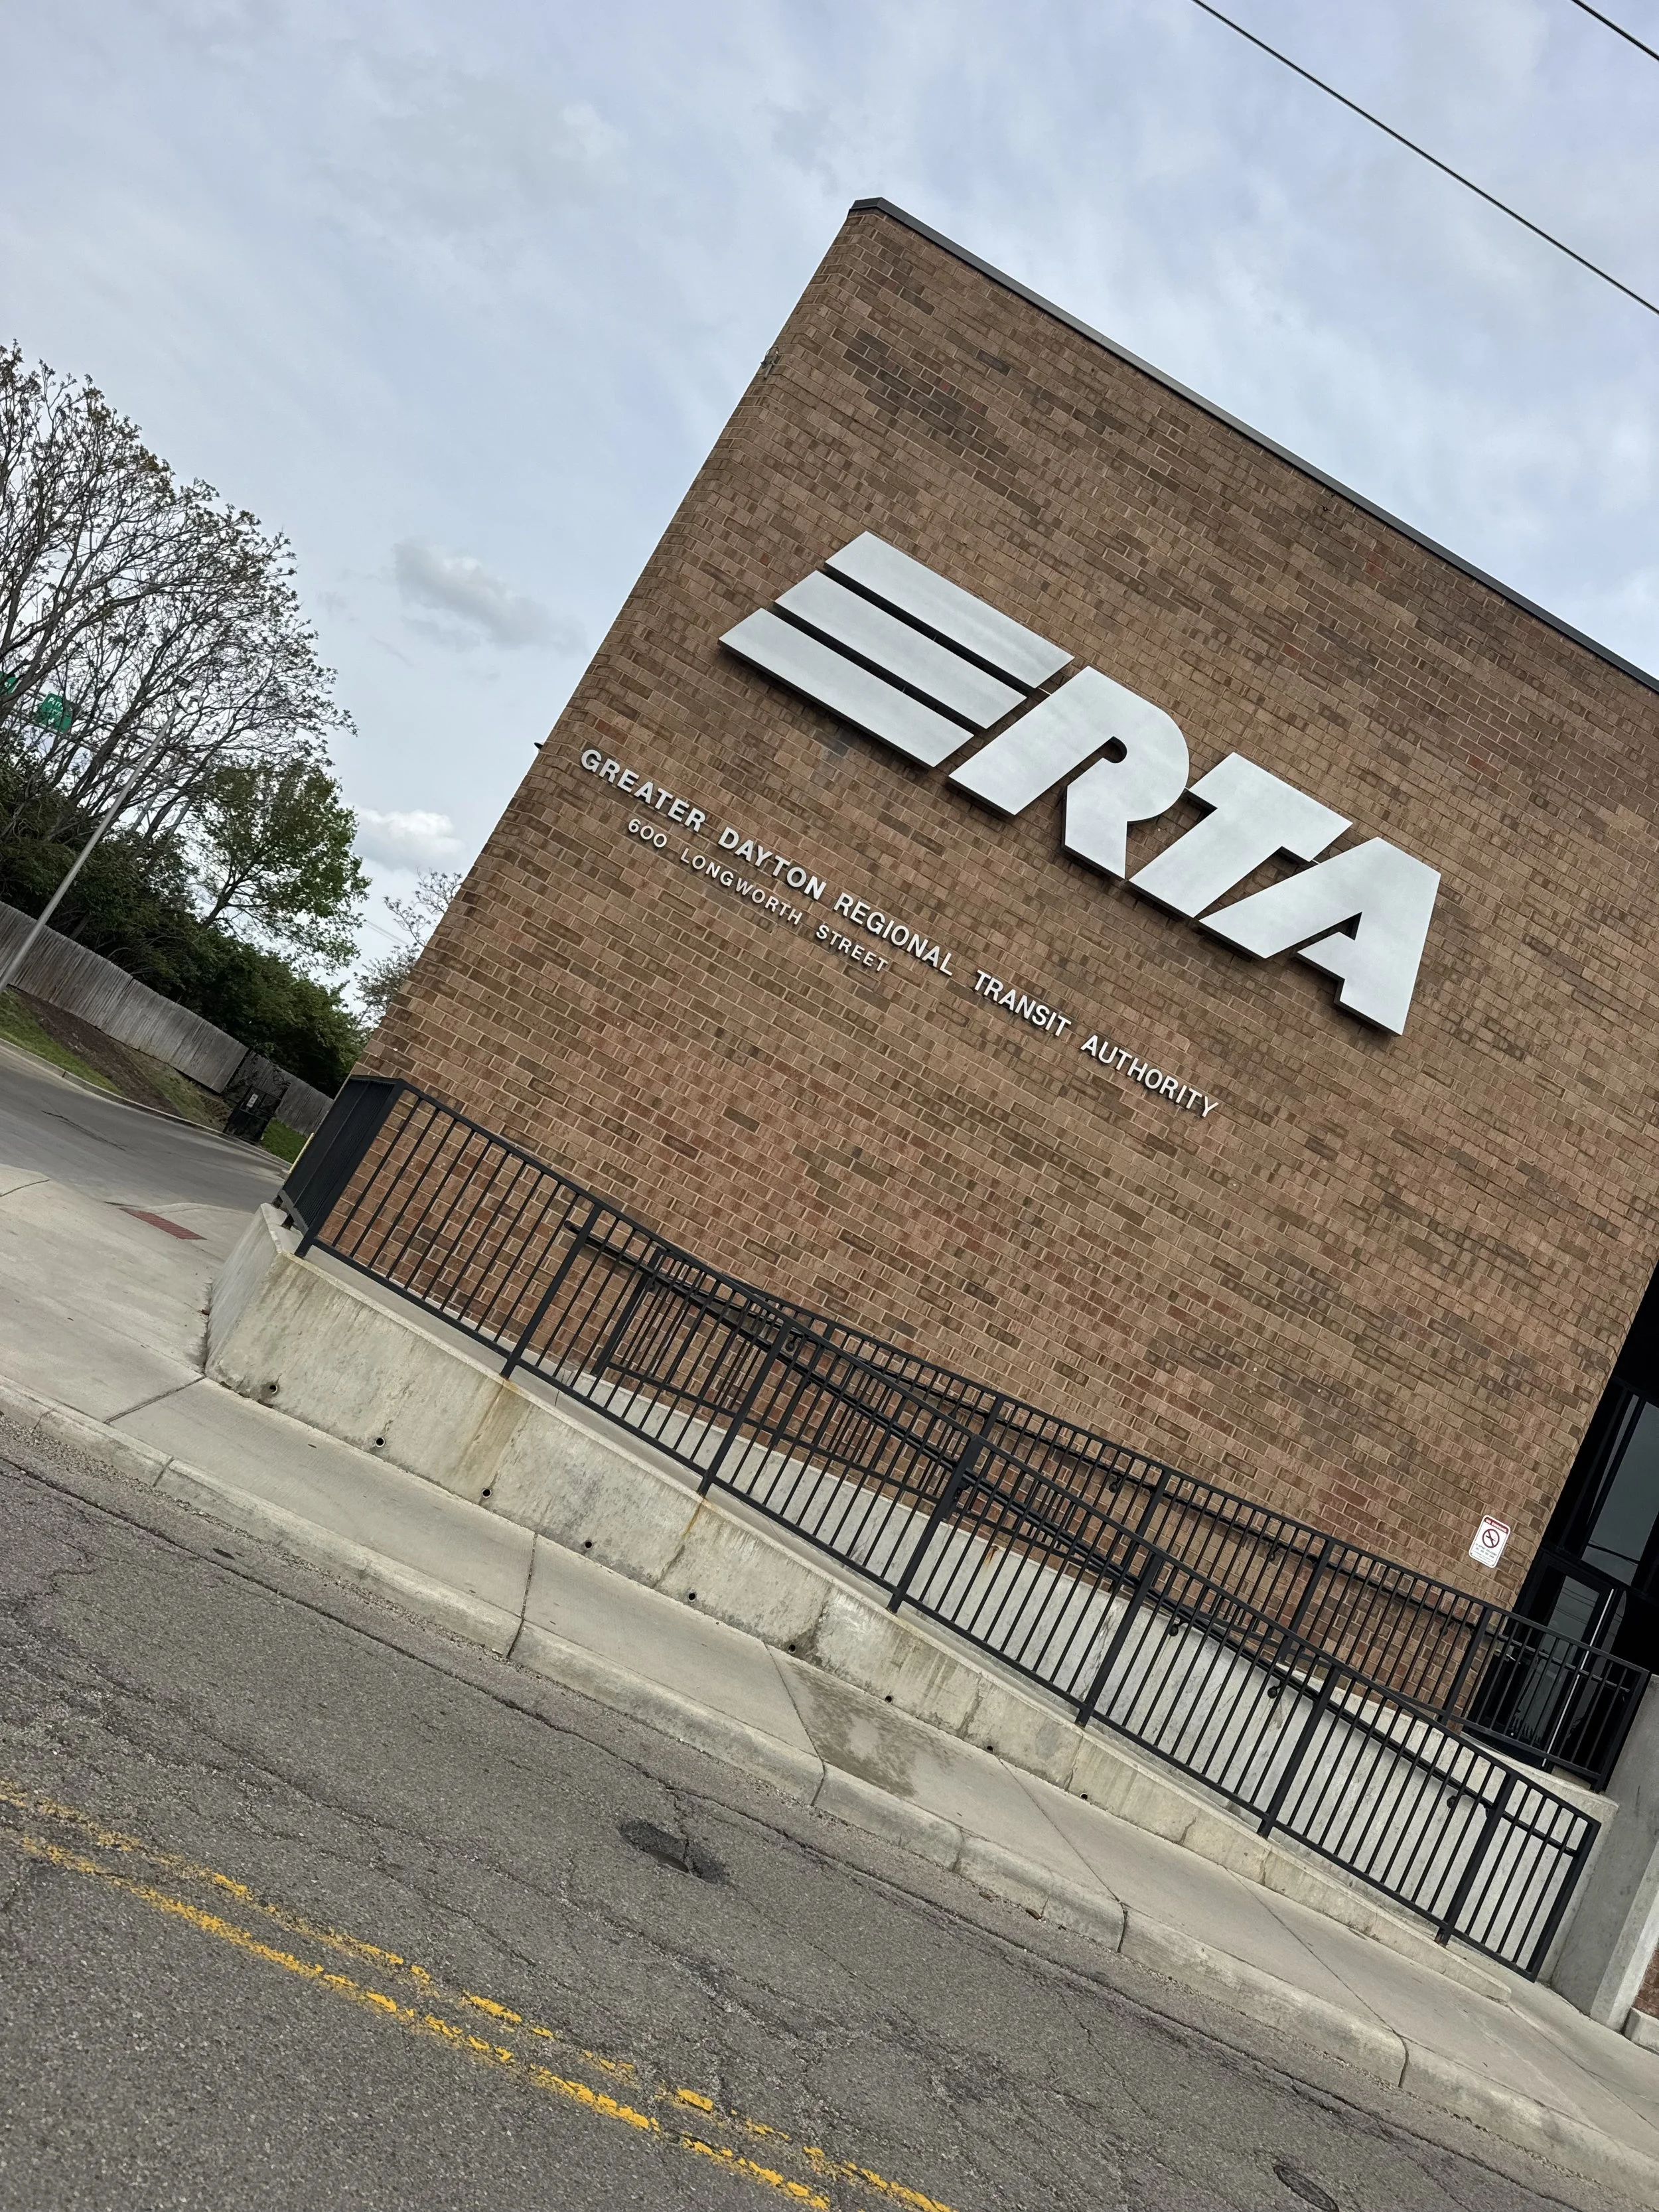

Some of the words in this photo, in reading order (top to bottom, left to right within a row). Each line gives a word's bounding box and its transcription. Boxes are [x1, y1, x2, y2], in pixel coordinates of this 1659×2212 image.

[581, 749, 705, 832] GREATER
[717, 827, 826, 901] DAYTON
[833, 892, 953, 976] REGIONAL
[972, 969, 1072, 1037] TRANSIT
[1080, 1034, 1219, 1118] AUTHORITY
[628, 818, 668, 848] 600
[680, 848, 803, 925] LONGWORTH
[816, 924, 888, 972] STREET
[948, 666, 1441, 1036] RTA
